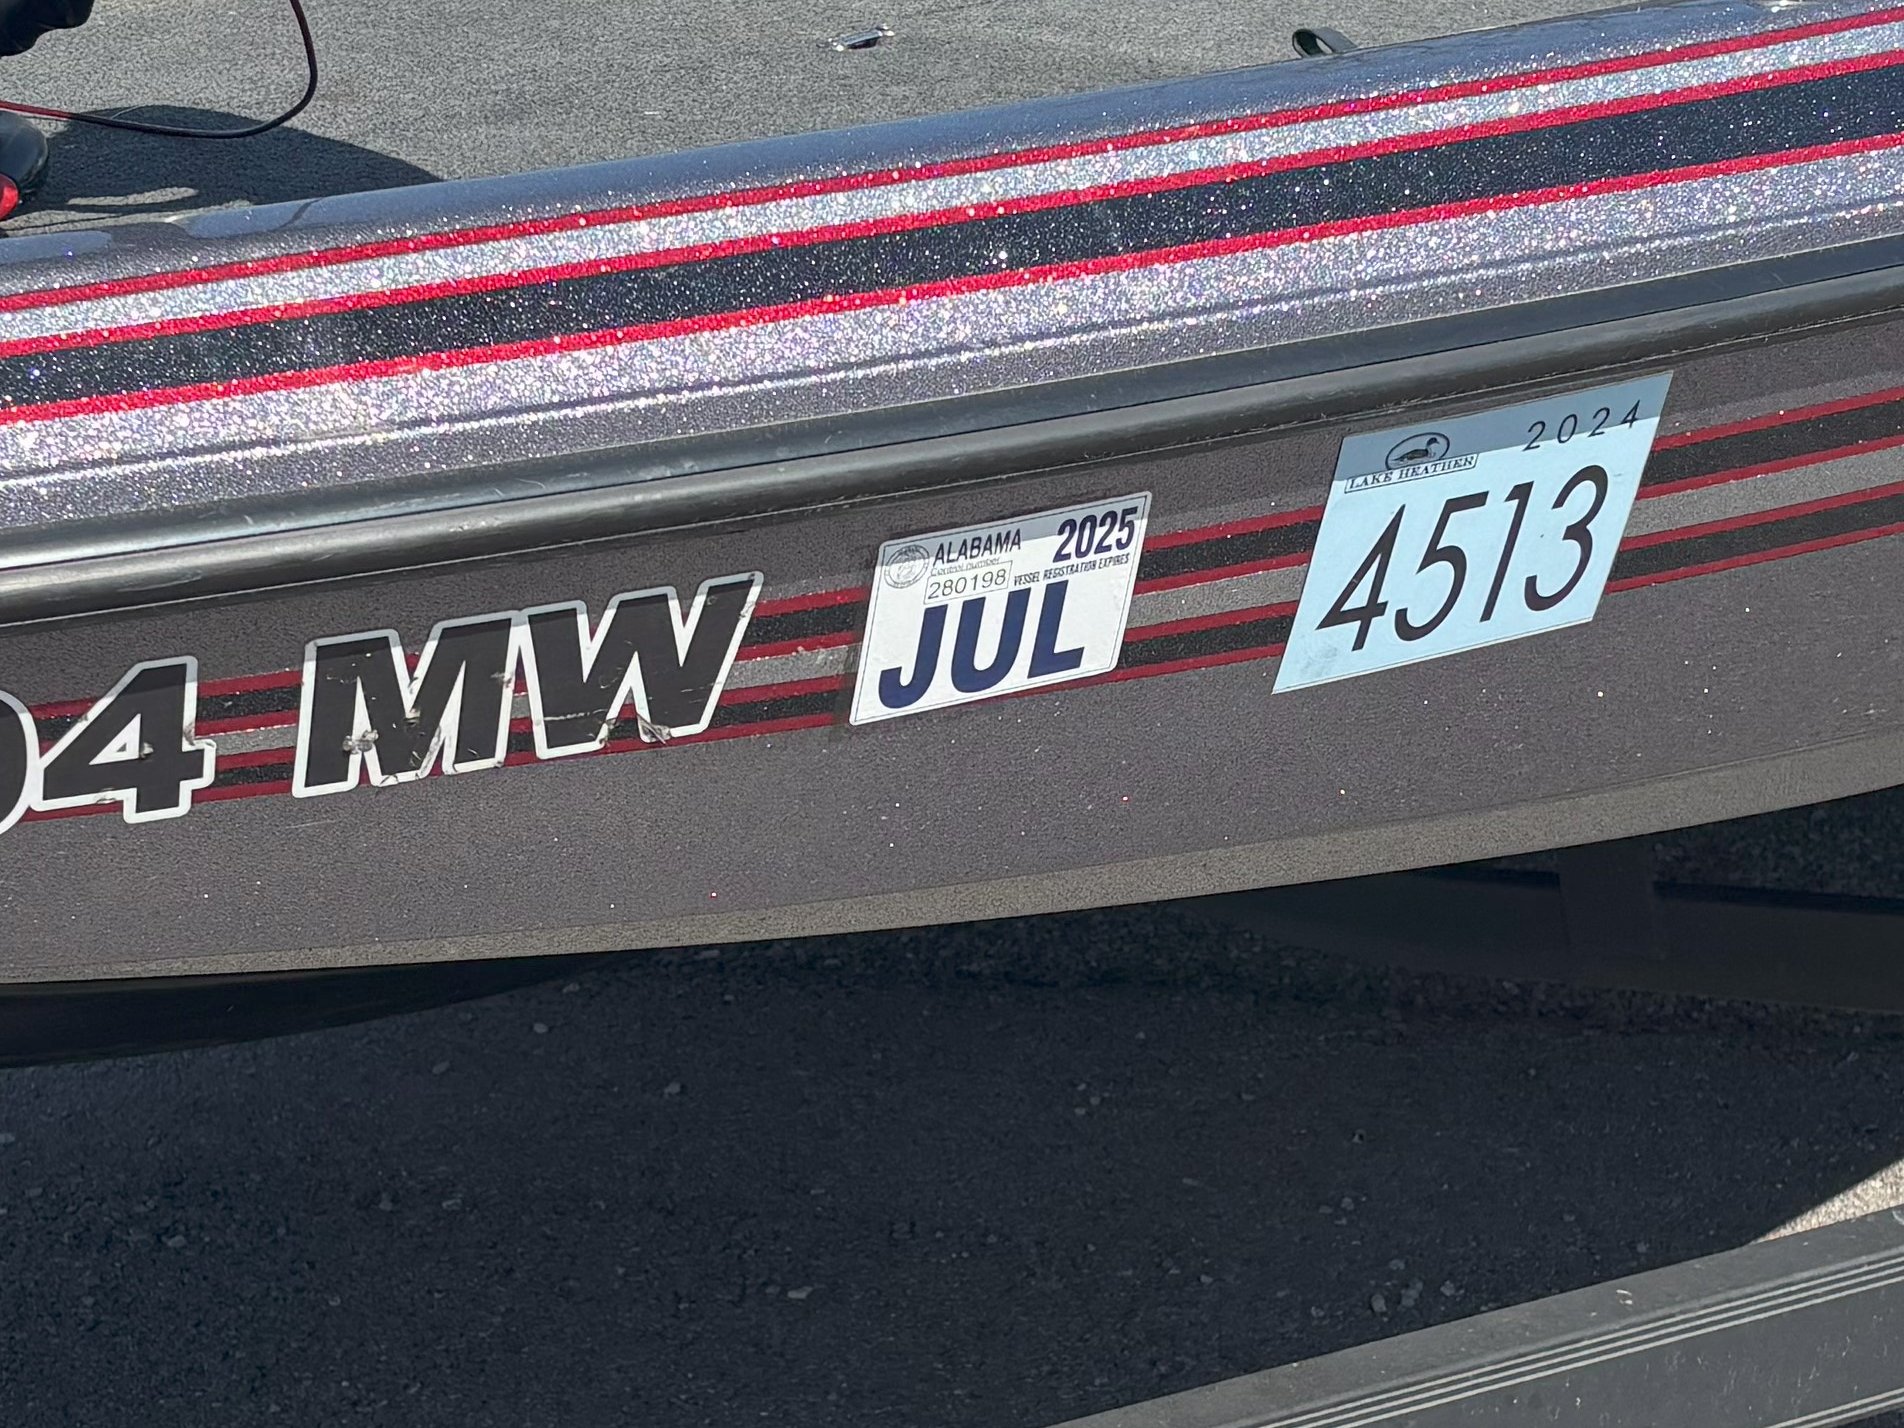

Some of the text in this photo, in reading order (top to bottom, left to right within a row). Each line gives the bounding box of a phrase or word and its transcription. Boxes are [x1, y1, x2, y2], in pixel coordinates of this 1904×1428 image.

[1522, 400, 1641, 452] 2024
[1349, 456, 1475, 489] LAKE HEATHER
[932, 528, 1022, 567] ALABAMA
[1052, 505, 1139, 563] 2025
[1098, 553, 1130, 570] EXPIRES
[1315, 464, 1609, 652] 4513
[927, 569, 1007, 600] 280198
[878, 579, 1085, 709] JUL
[292, 571, 764, 798] MW
